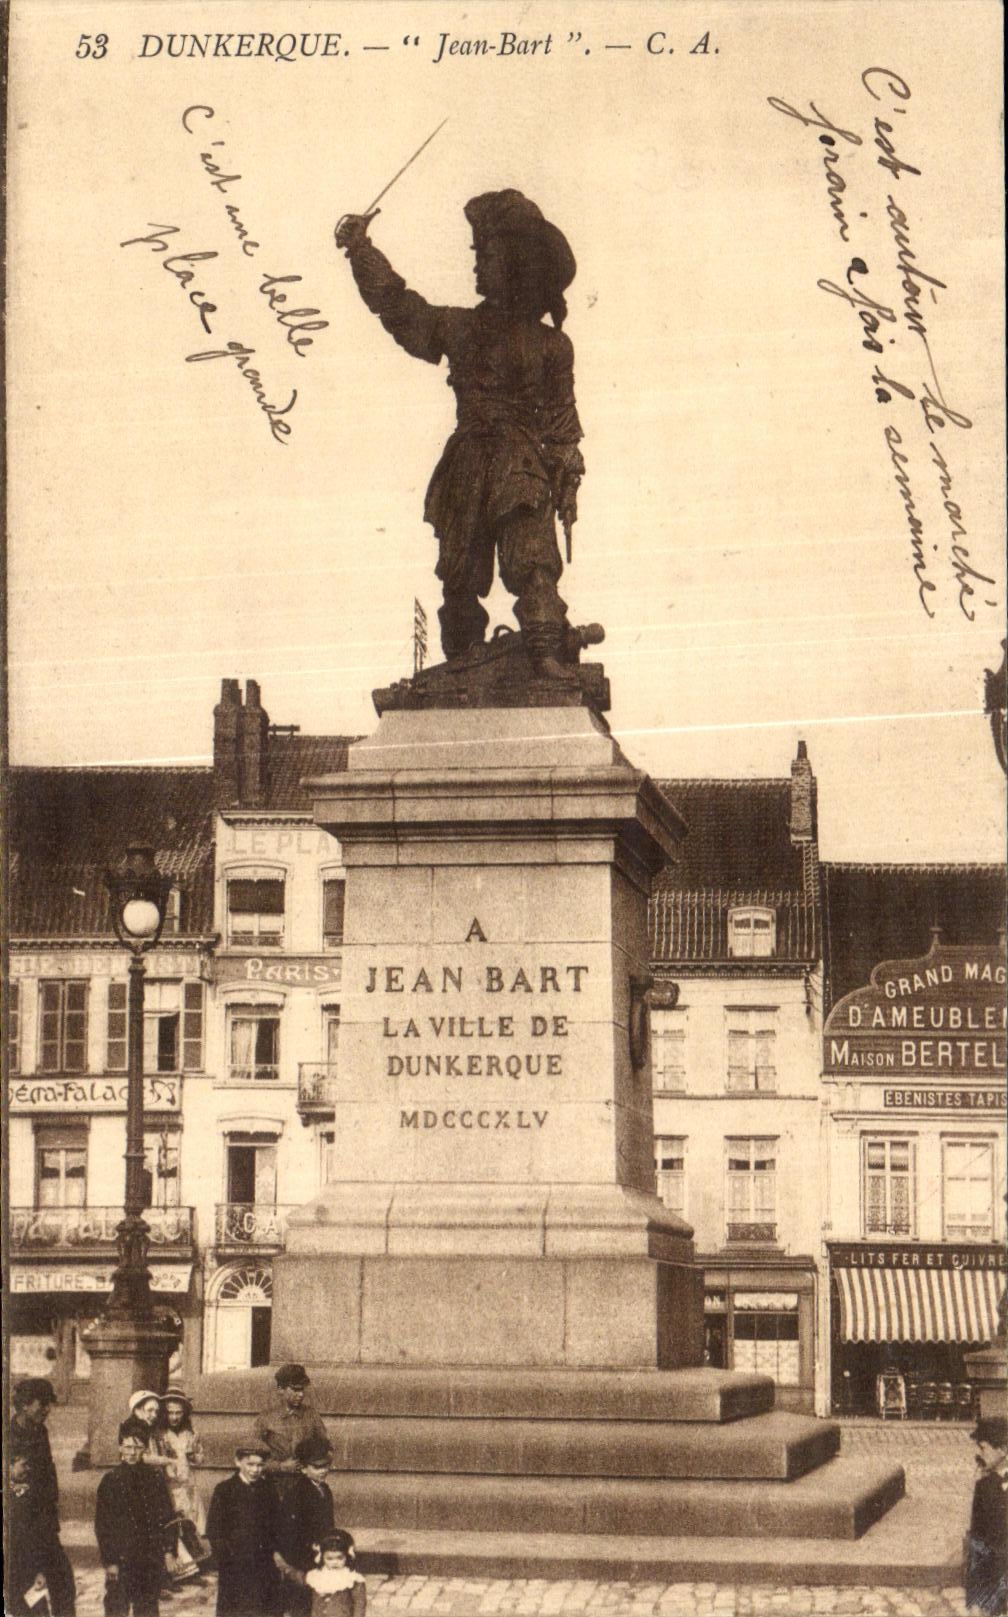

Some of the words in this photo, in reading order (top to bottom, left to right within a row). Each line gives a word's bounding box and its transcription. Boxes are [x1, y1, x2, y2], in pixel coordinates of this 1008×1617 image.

[259, 273, 330, 358] belle
[119, 222, 220, 334] place
[185, 341, 299, 446] grande
[884, 424, 940, 619] semaine
[929, 441, 998, 622] marché
[464, 917, 488, 943] A
[365, 966, 463, 994] JEAN
[485, 965, 589, 994] BART
[885, 965, 953, 998] GRAND
[382, 1016, 421, 1038] LA
[428, 1016, 515, 1038] VILLE
[530, 1016, 569, 1037] DE
[387, 1054, 563, 1080] DUNKERQUE
[400, 1110, 548, 1129] MDCCCXLV
[850, 1252, 885, 1265] LITS
[892, 1253, 919, 1265] FER
[926, 1253, 943, 1265] ET
